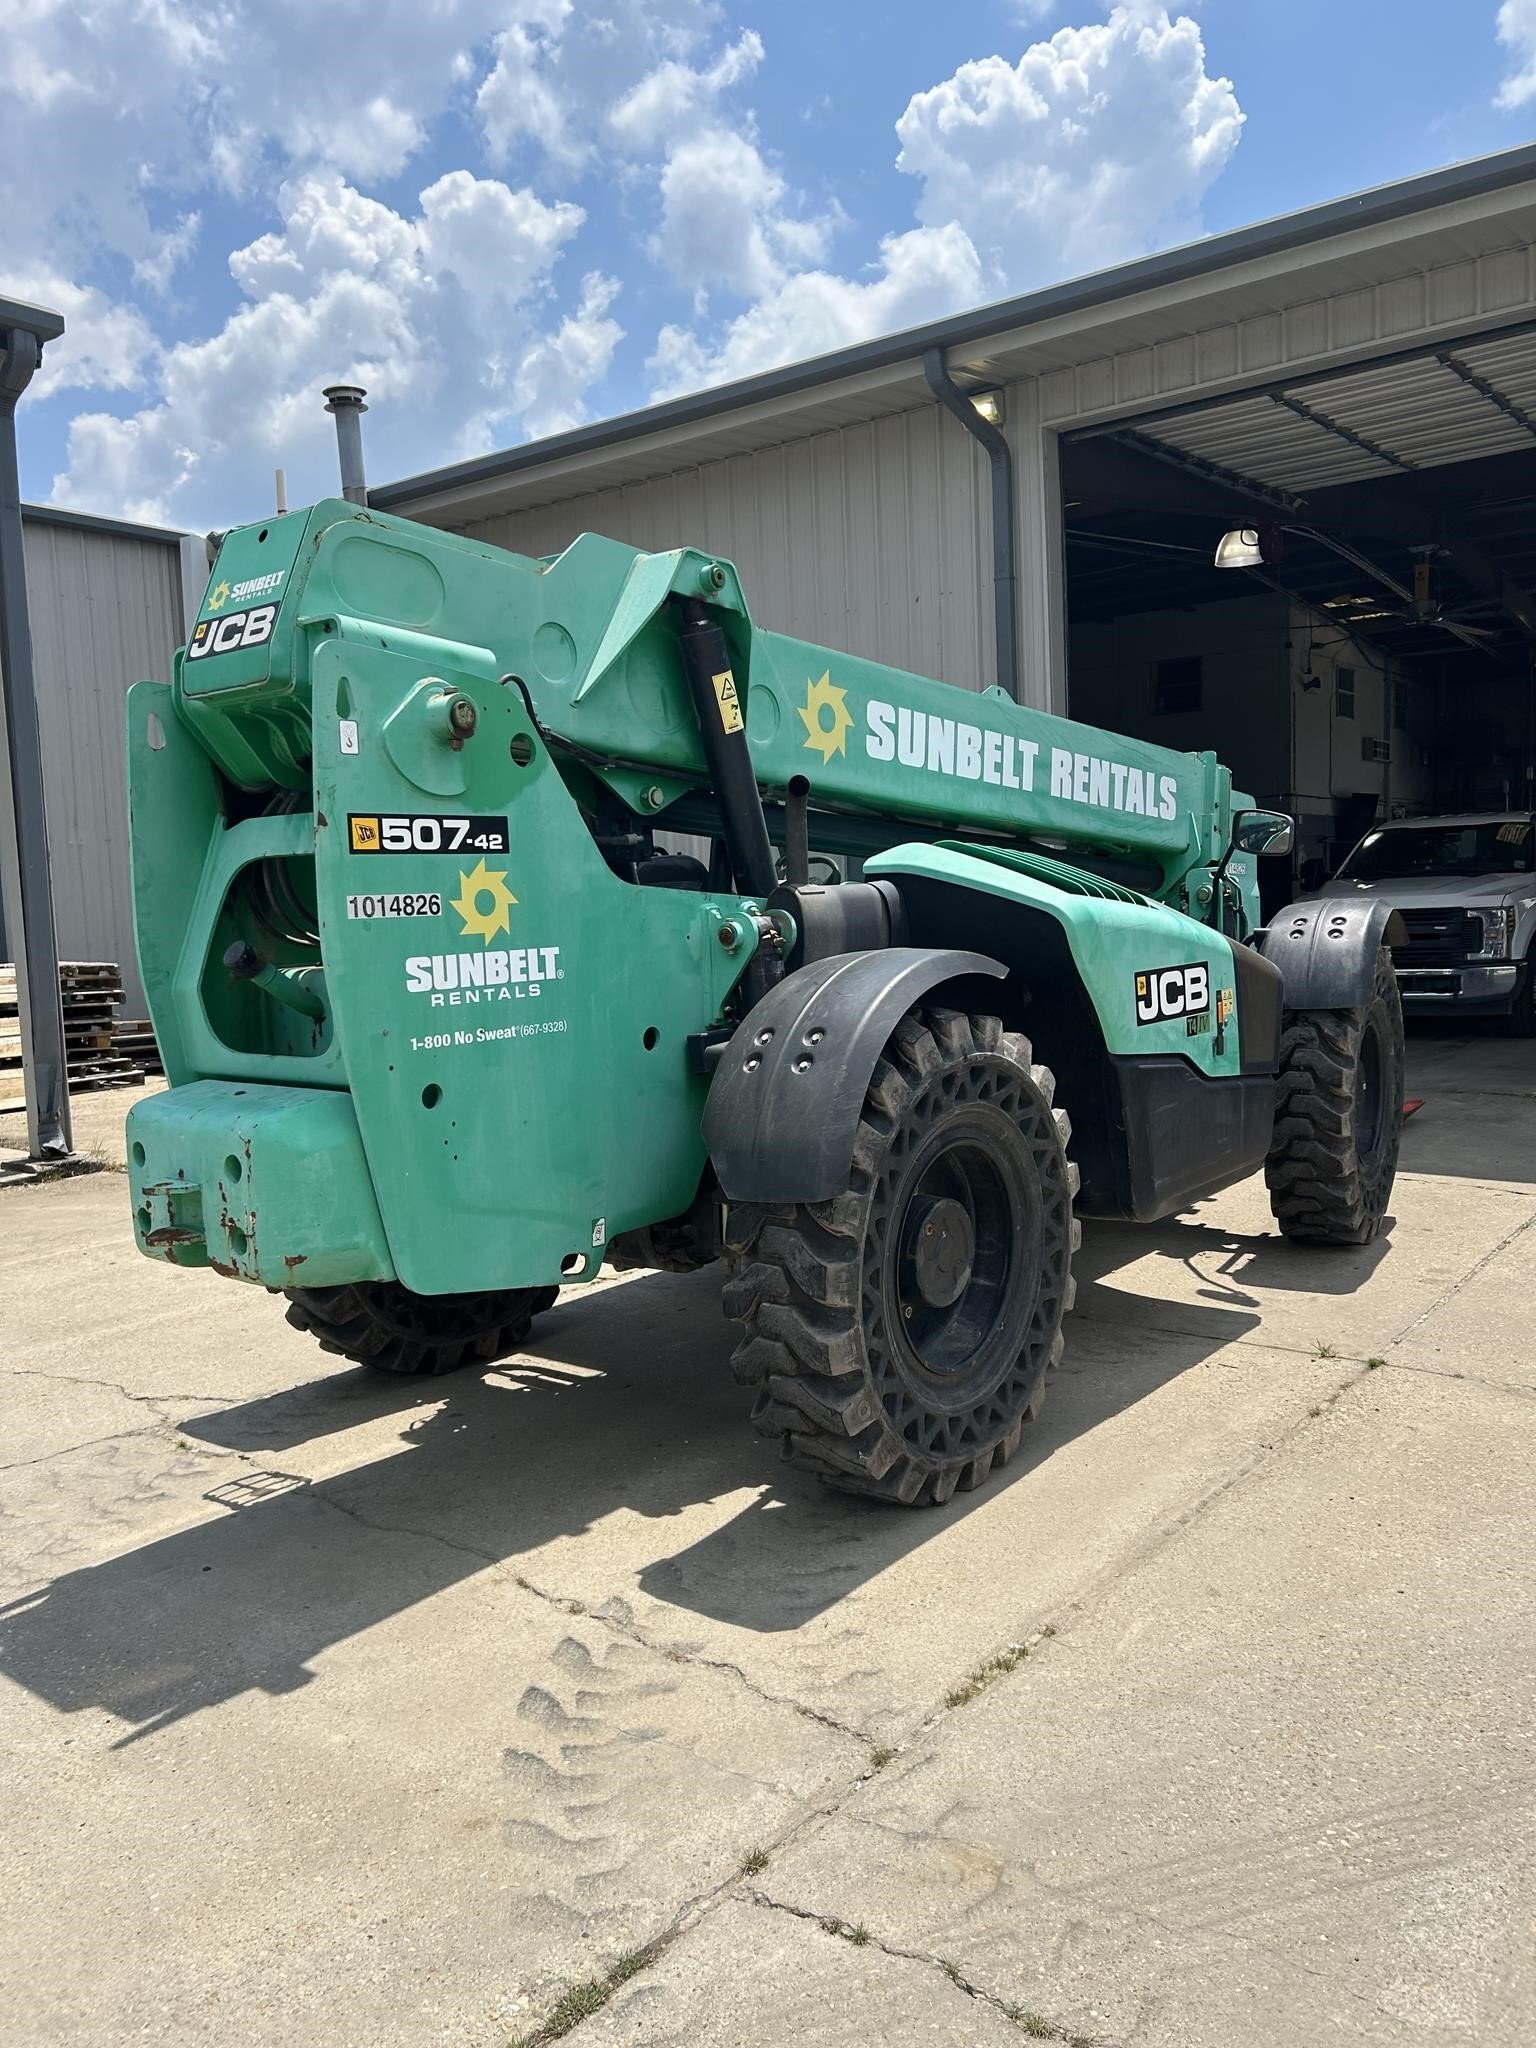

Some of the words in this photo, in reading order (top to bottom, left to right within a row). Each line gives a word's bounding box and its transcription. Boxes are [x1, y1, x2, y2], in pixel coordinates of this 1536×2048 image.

[230, 570, 285, 598] SUNBELT
[235, 588, 273, 603] RENTALS
[189, 605, 276, 658] JCB
[866, 700, 1039, 792] SUNBELT
[1051, 747, 1177, 821] RENTALS
[381, 818, 503, 850] 507-42
[349, 894, 441, 918] 1014826
[431, 983, 541, 1007] RENTALS
[1138, 966, 1209, 1021] JCB
[410, 1033, 451, 1051] 1-800
[454, 1030, 473, 1045] No
[520, 1019, 568, 1038] (667-9328)
